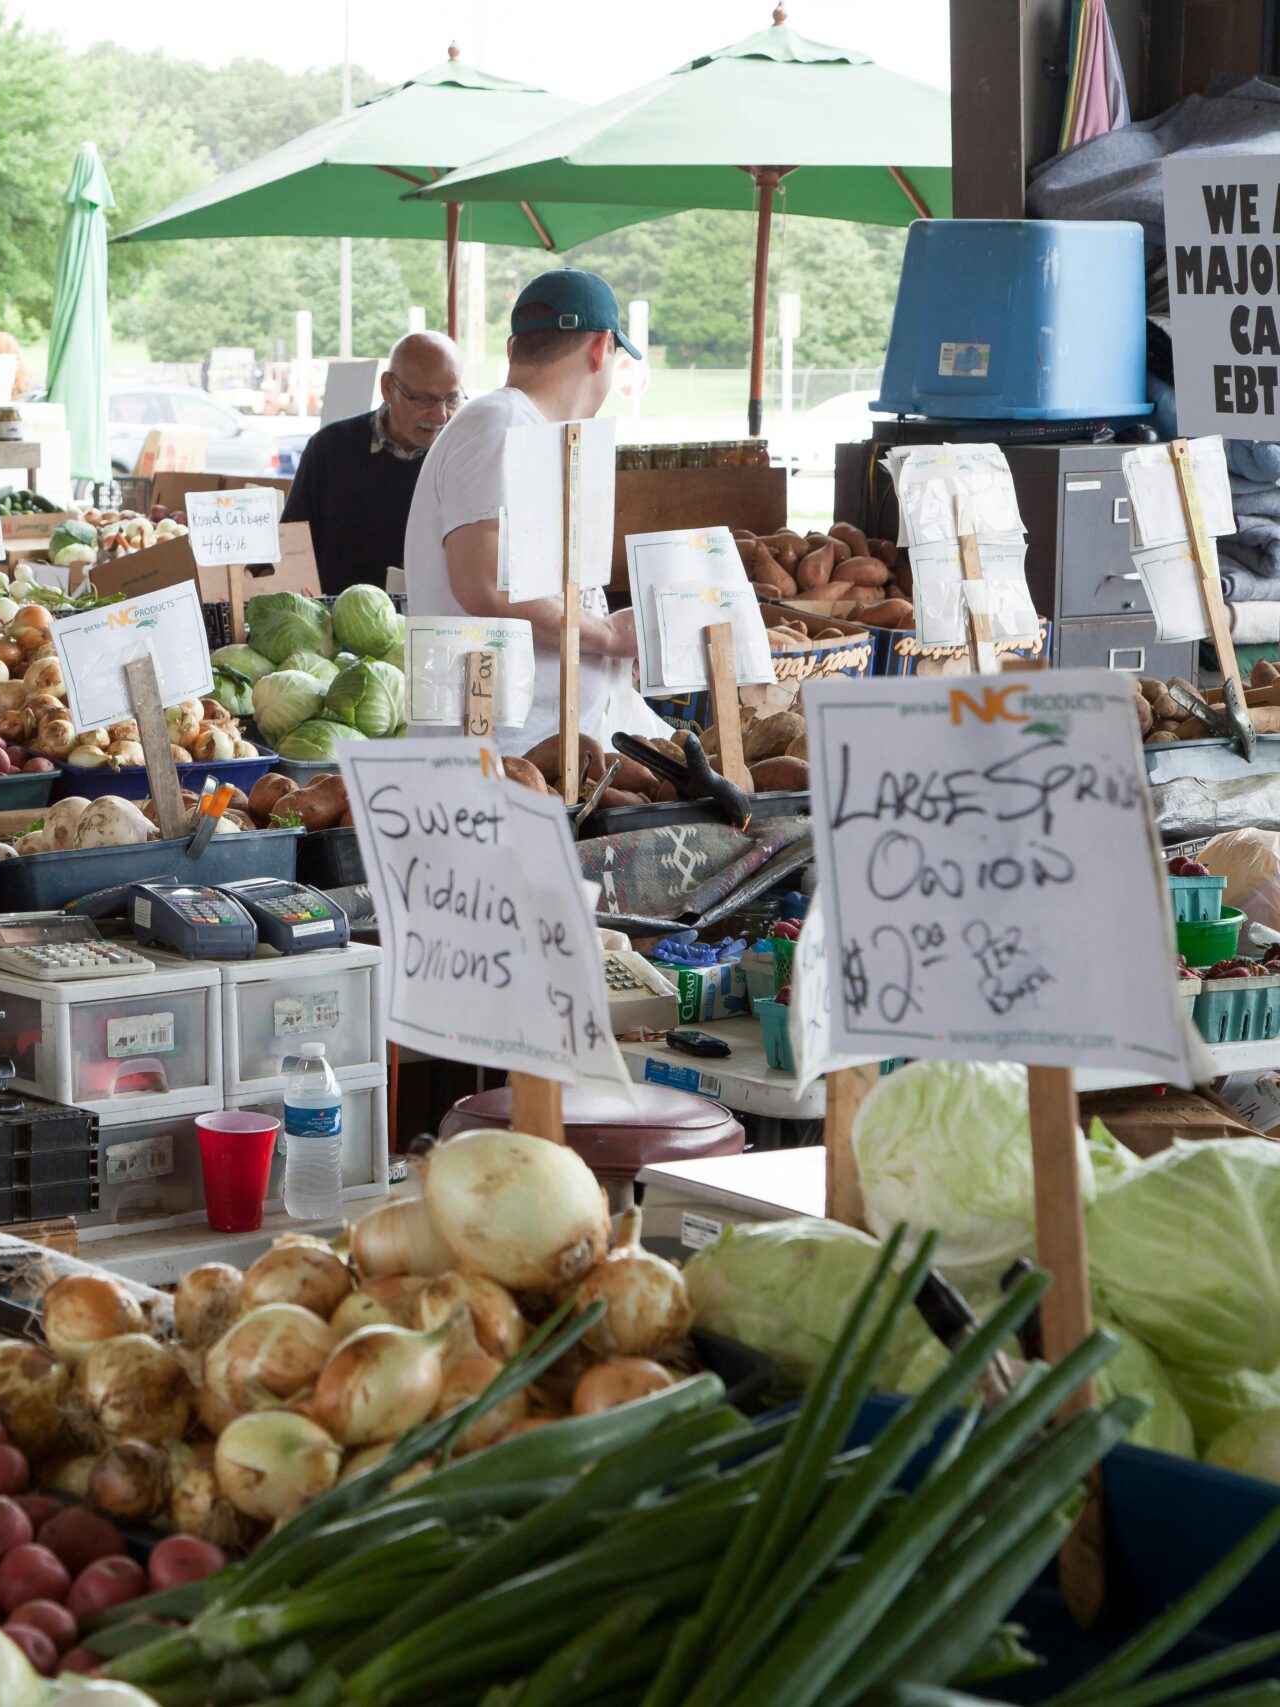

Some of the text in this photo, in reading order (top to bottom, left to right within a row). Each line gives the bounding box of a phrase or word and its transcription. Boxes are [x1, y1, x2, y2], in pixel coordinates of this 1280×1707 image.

[1201, 184, 1261, 234] WE
[1175, 244, 1280, 295] MAJO
[1213, 365, 1278, 415] EBT
[83, 625, 94, 633] got
[107, 604, 141, 631] NC
[134, 599, 175, 618] PRODUCTS
[949, 685, 1031, 726] NC
[370, 785, 506, 844] Sweet
[388, 857, 521, 931] Vidalia
[405, 931, 513, 989] Onions
